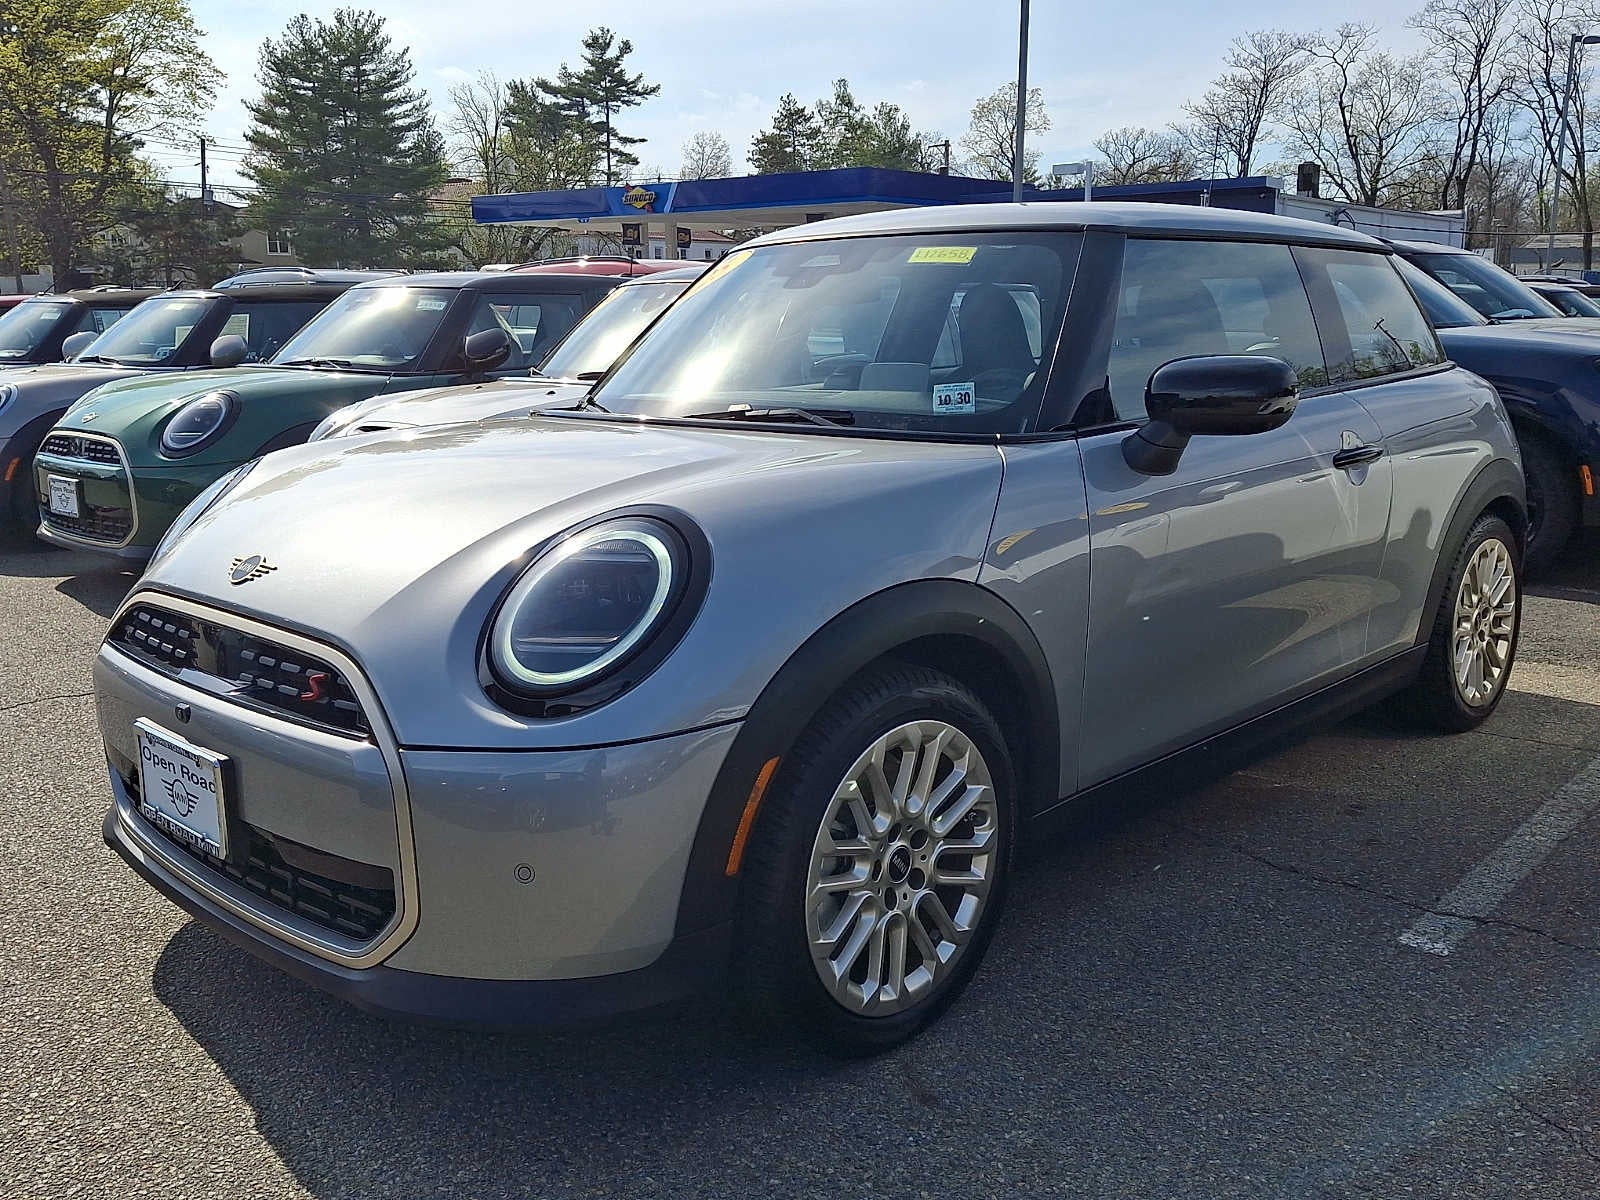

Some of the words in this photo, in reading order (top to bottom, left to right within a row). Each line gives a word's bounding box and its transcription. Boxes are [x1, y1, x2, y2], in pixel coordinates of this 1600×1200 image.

[624, 192, 654, 203] SUNOCO
[301, 674, 327, 701] S
[143, 745, 176, 775] Open
[144, 807, 168, 829] OPEN
[170, 822, 196, 845] ROAD
[197, 838, 220, 857] MINI
[892, 854, 907, 874] MINI
